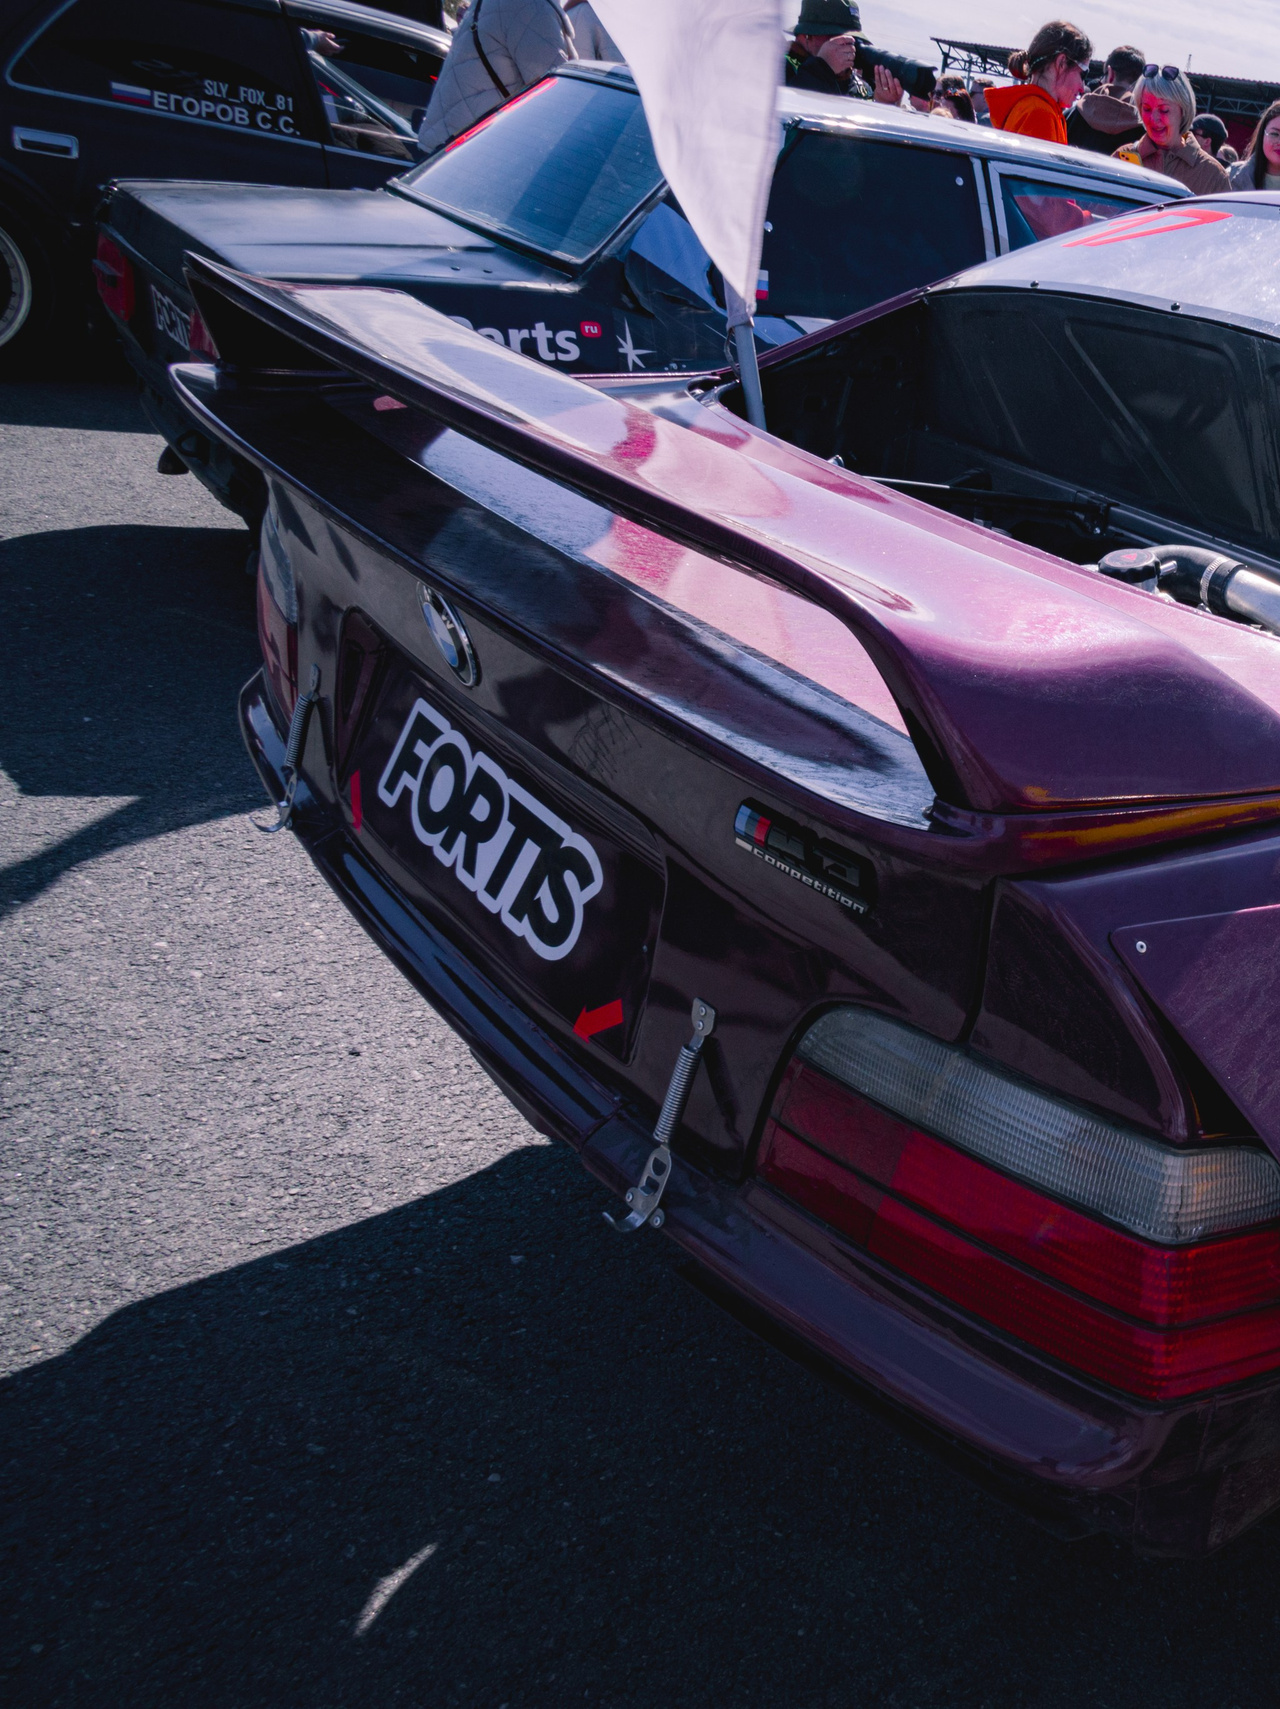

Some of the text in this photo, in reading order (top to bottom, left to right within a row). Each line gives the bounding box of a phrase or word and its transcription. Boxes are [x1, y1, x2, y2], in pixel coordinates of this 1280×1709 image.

[152, 90, 249, 126] ЕГОРОВ
[203, 79, 294, 112] SLY_FOX_81
[583, 324, 599, 335] ru
[752, 846, 867, 915] competition
